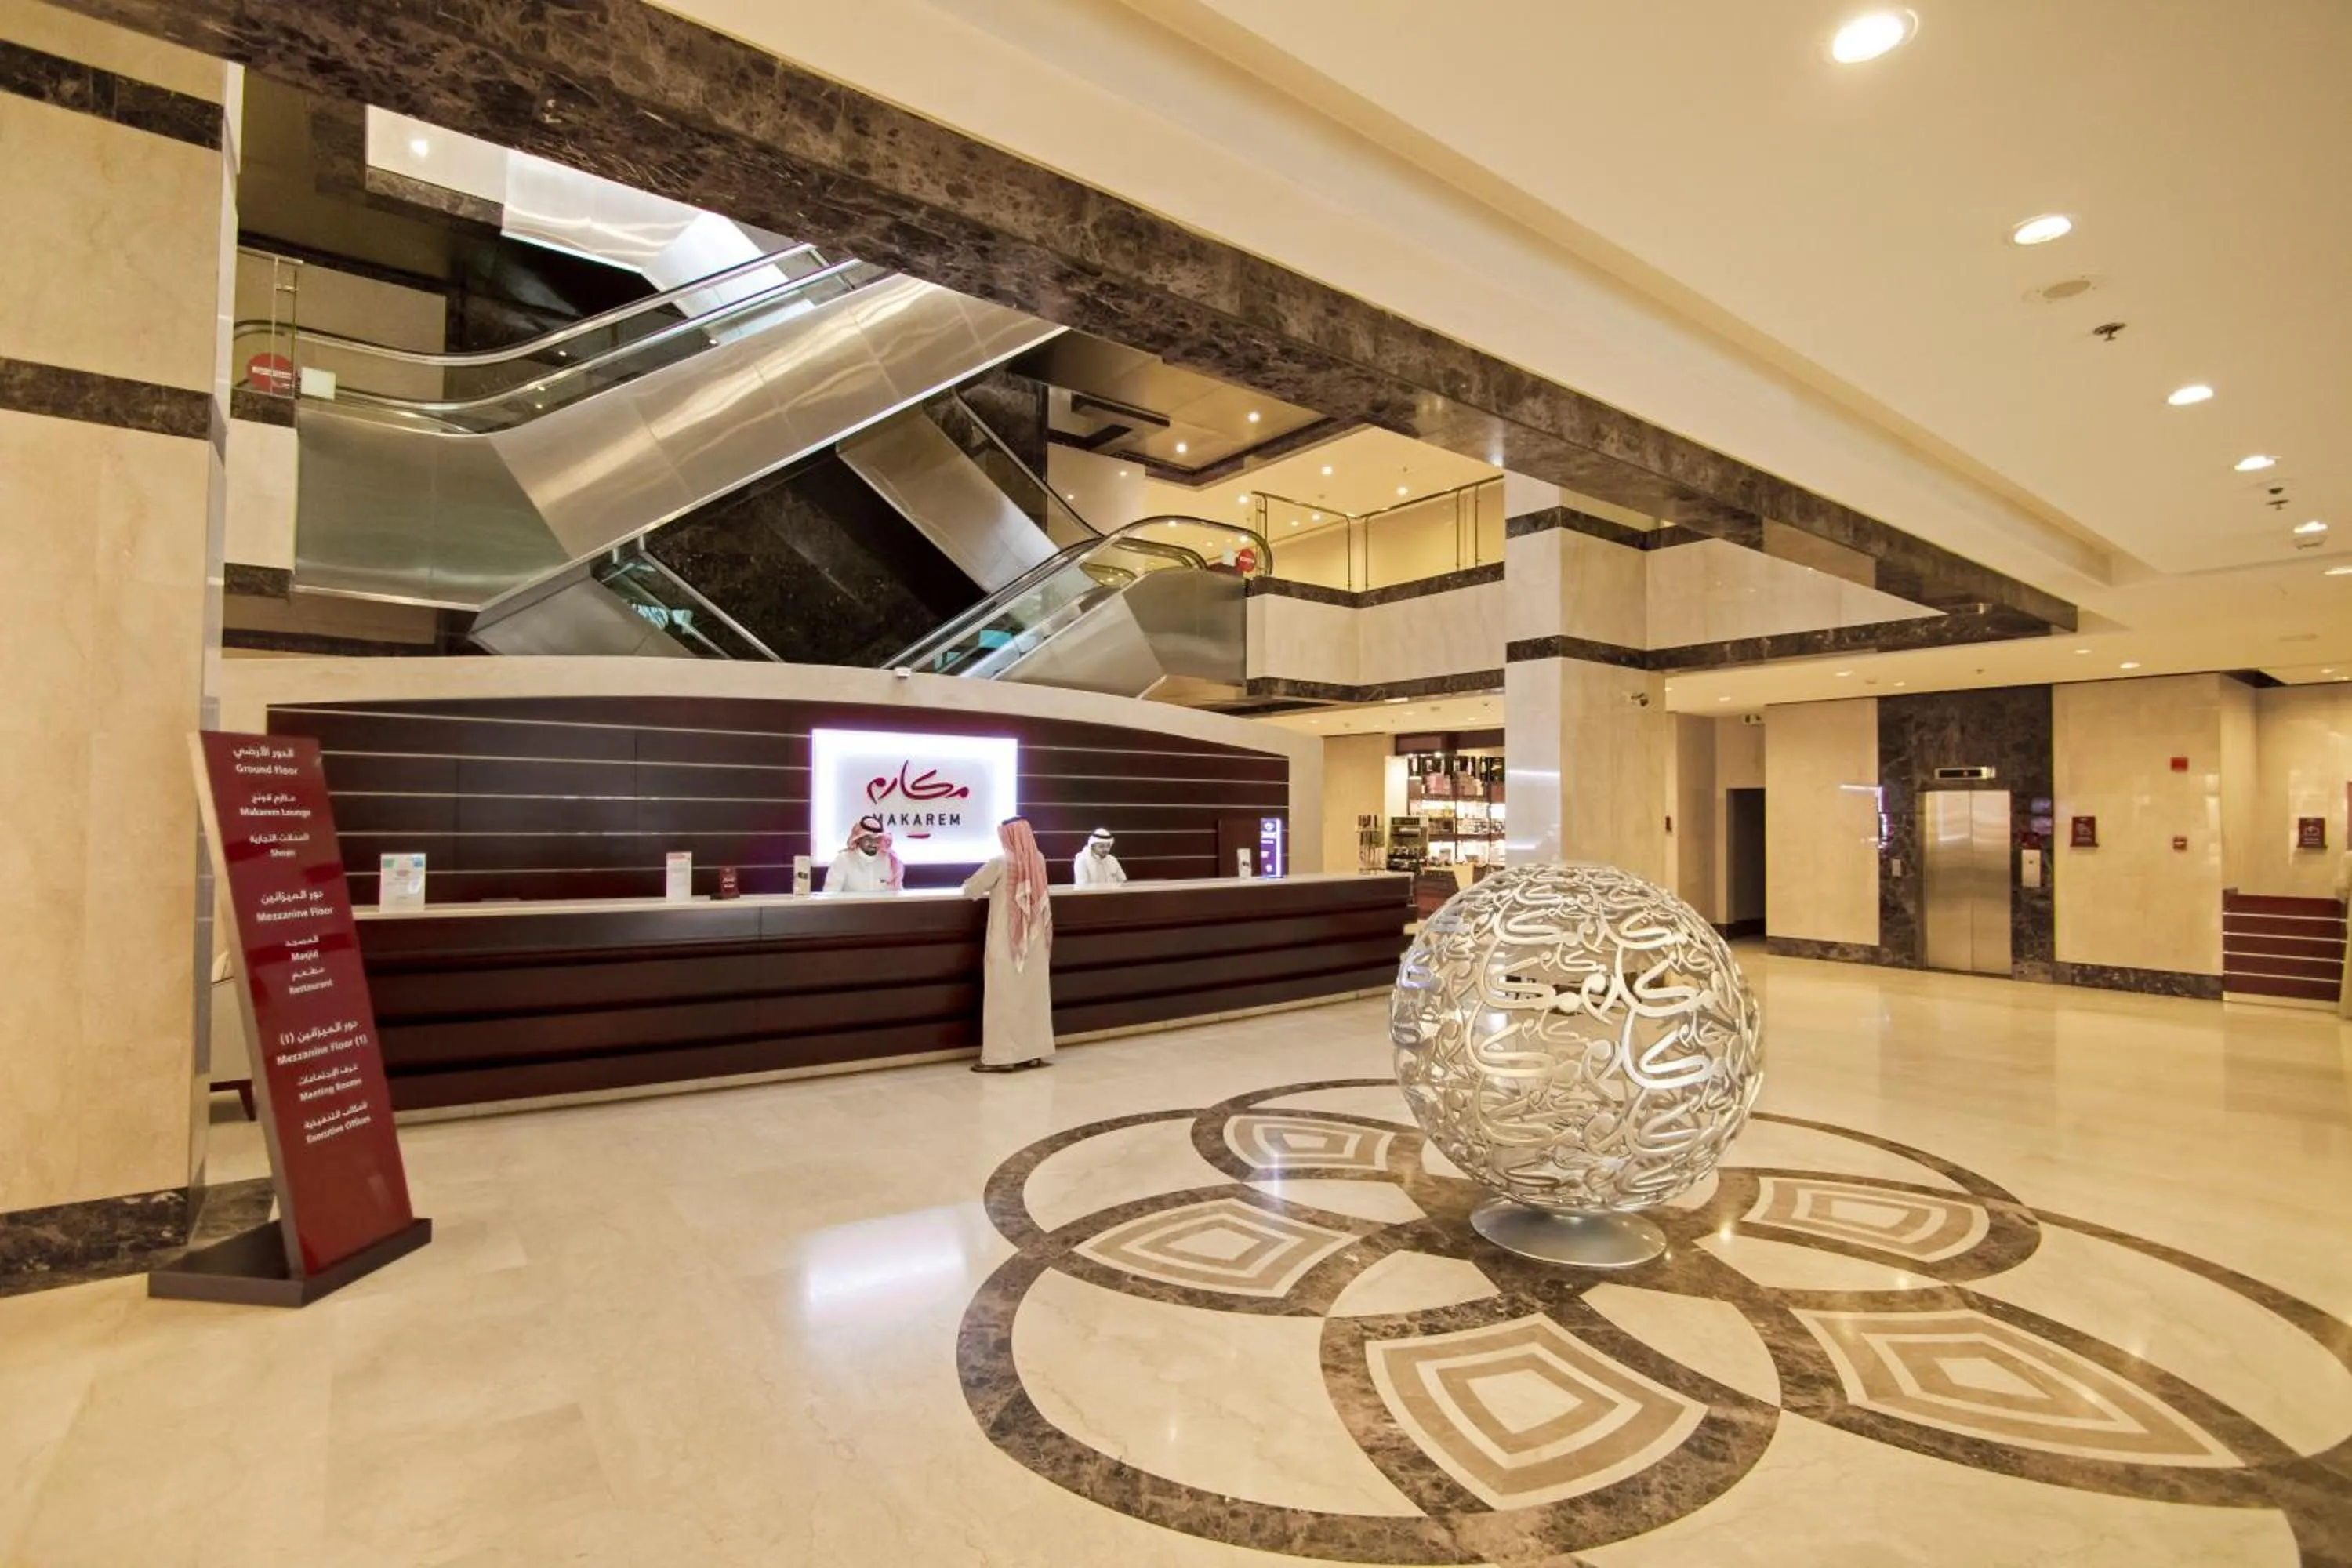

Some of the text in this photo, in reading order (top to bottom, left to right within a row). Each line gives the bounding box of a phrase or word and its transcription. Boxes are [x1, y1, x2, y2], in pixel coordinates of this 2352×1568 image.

[236, 764, 298, 775] Ground Floor
[866, 759, 970, 805] مكارم
[240, 807, 311, 818] Makarem Lounge
[256, 907, 333, 922] Mezzanine Floor
[289, 978, 334, 995] Restaurant
[277, 1047, 328, 1065] Mezzanine
[330, 1040, 353, 1051] Floor
[299, 1078, 362, 1102] Meeting Rooms
[306, 1116, 372, 1144] Executive Offices
